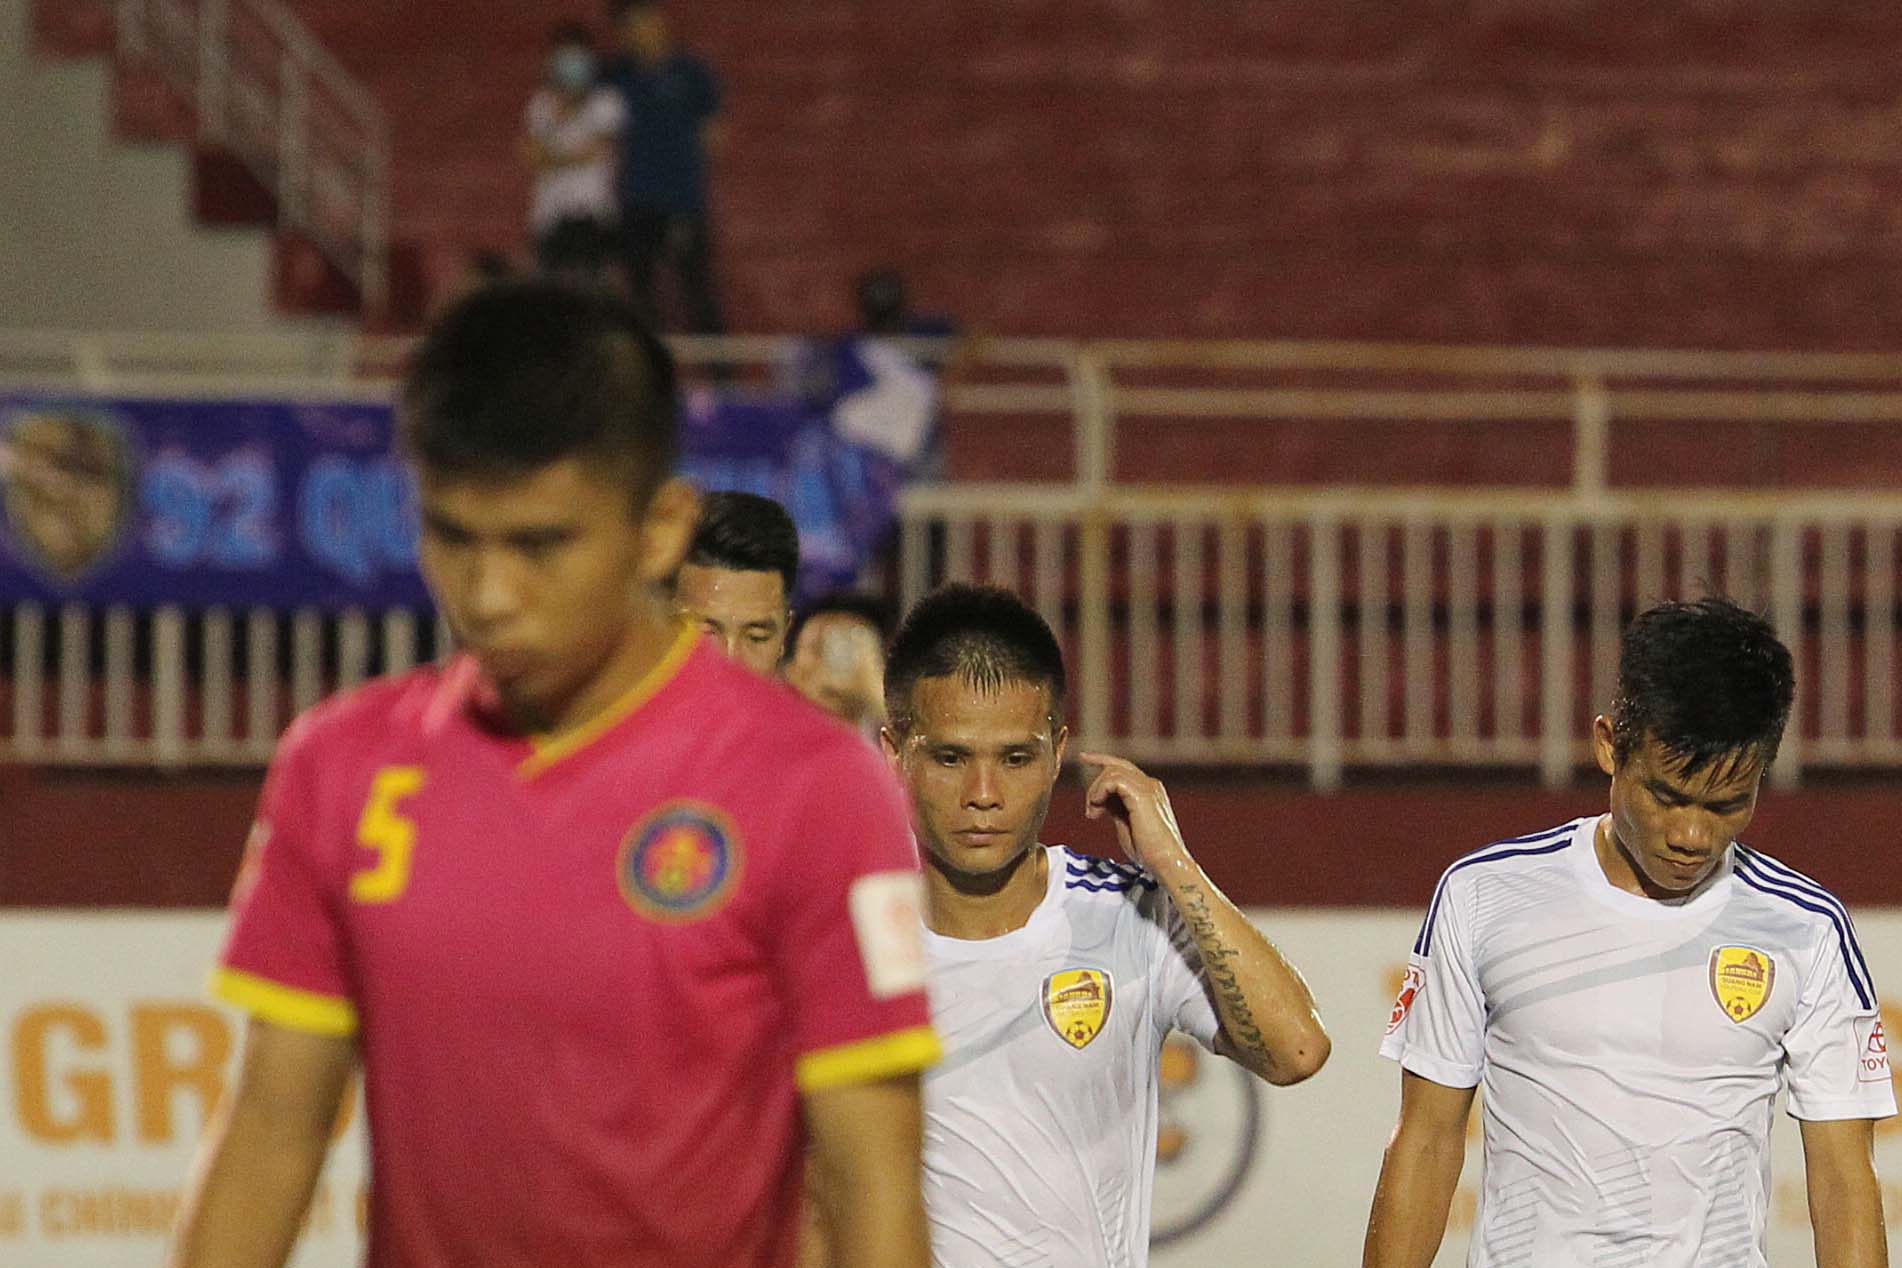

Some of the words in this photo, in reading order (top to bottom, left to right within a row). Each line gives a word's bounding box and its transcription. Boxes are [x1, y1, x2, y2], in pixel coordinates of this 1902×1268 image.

[350, 765, 424, 903] 5
[12, 1000, 236, 1146] GR
[1861, 1056, 1890, 1071] TOY
